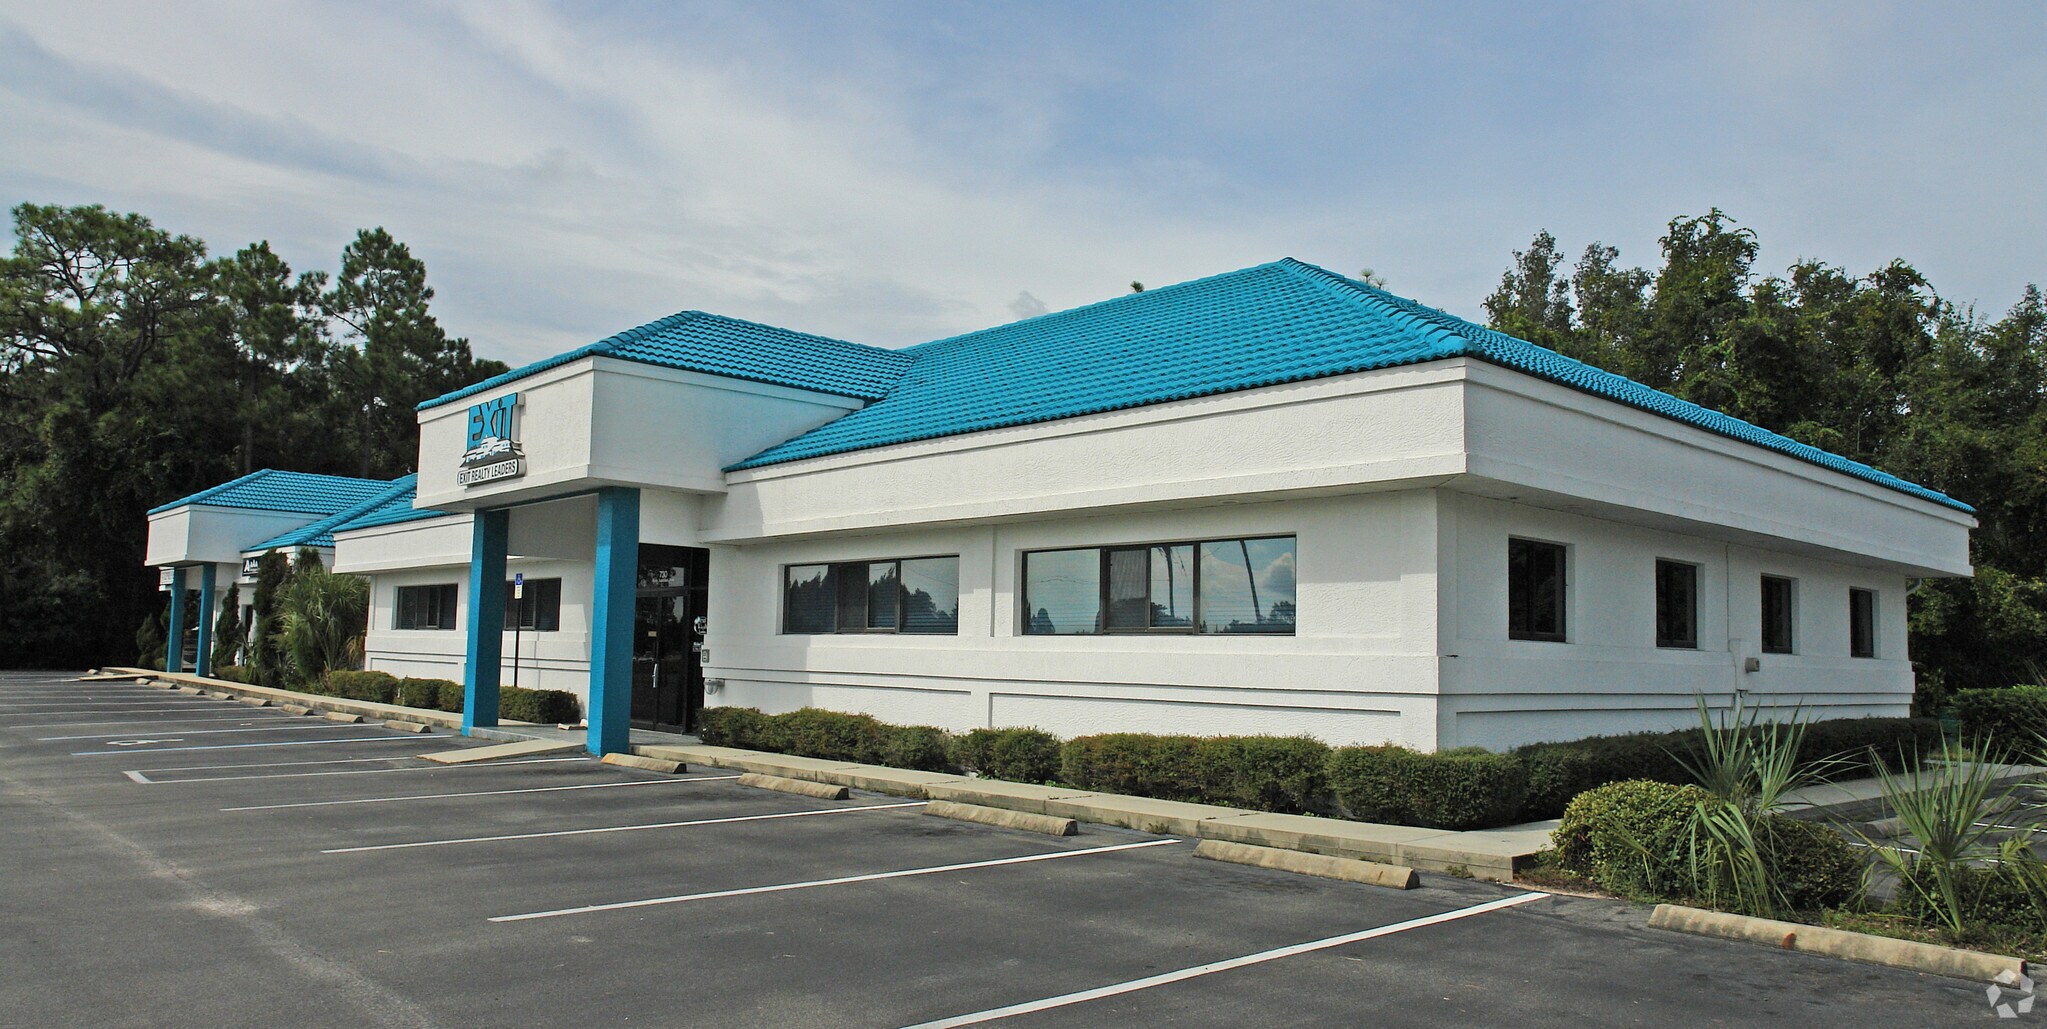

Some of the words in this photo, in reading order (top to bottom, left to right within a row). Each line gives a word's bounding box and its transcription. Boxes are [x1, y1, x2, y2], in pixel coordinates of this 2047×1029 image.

[460, 471, 471, 484] EXIT
[471, 467, 490, 481] REALTY
[491, 461, 516, 477] LEADERS
